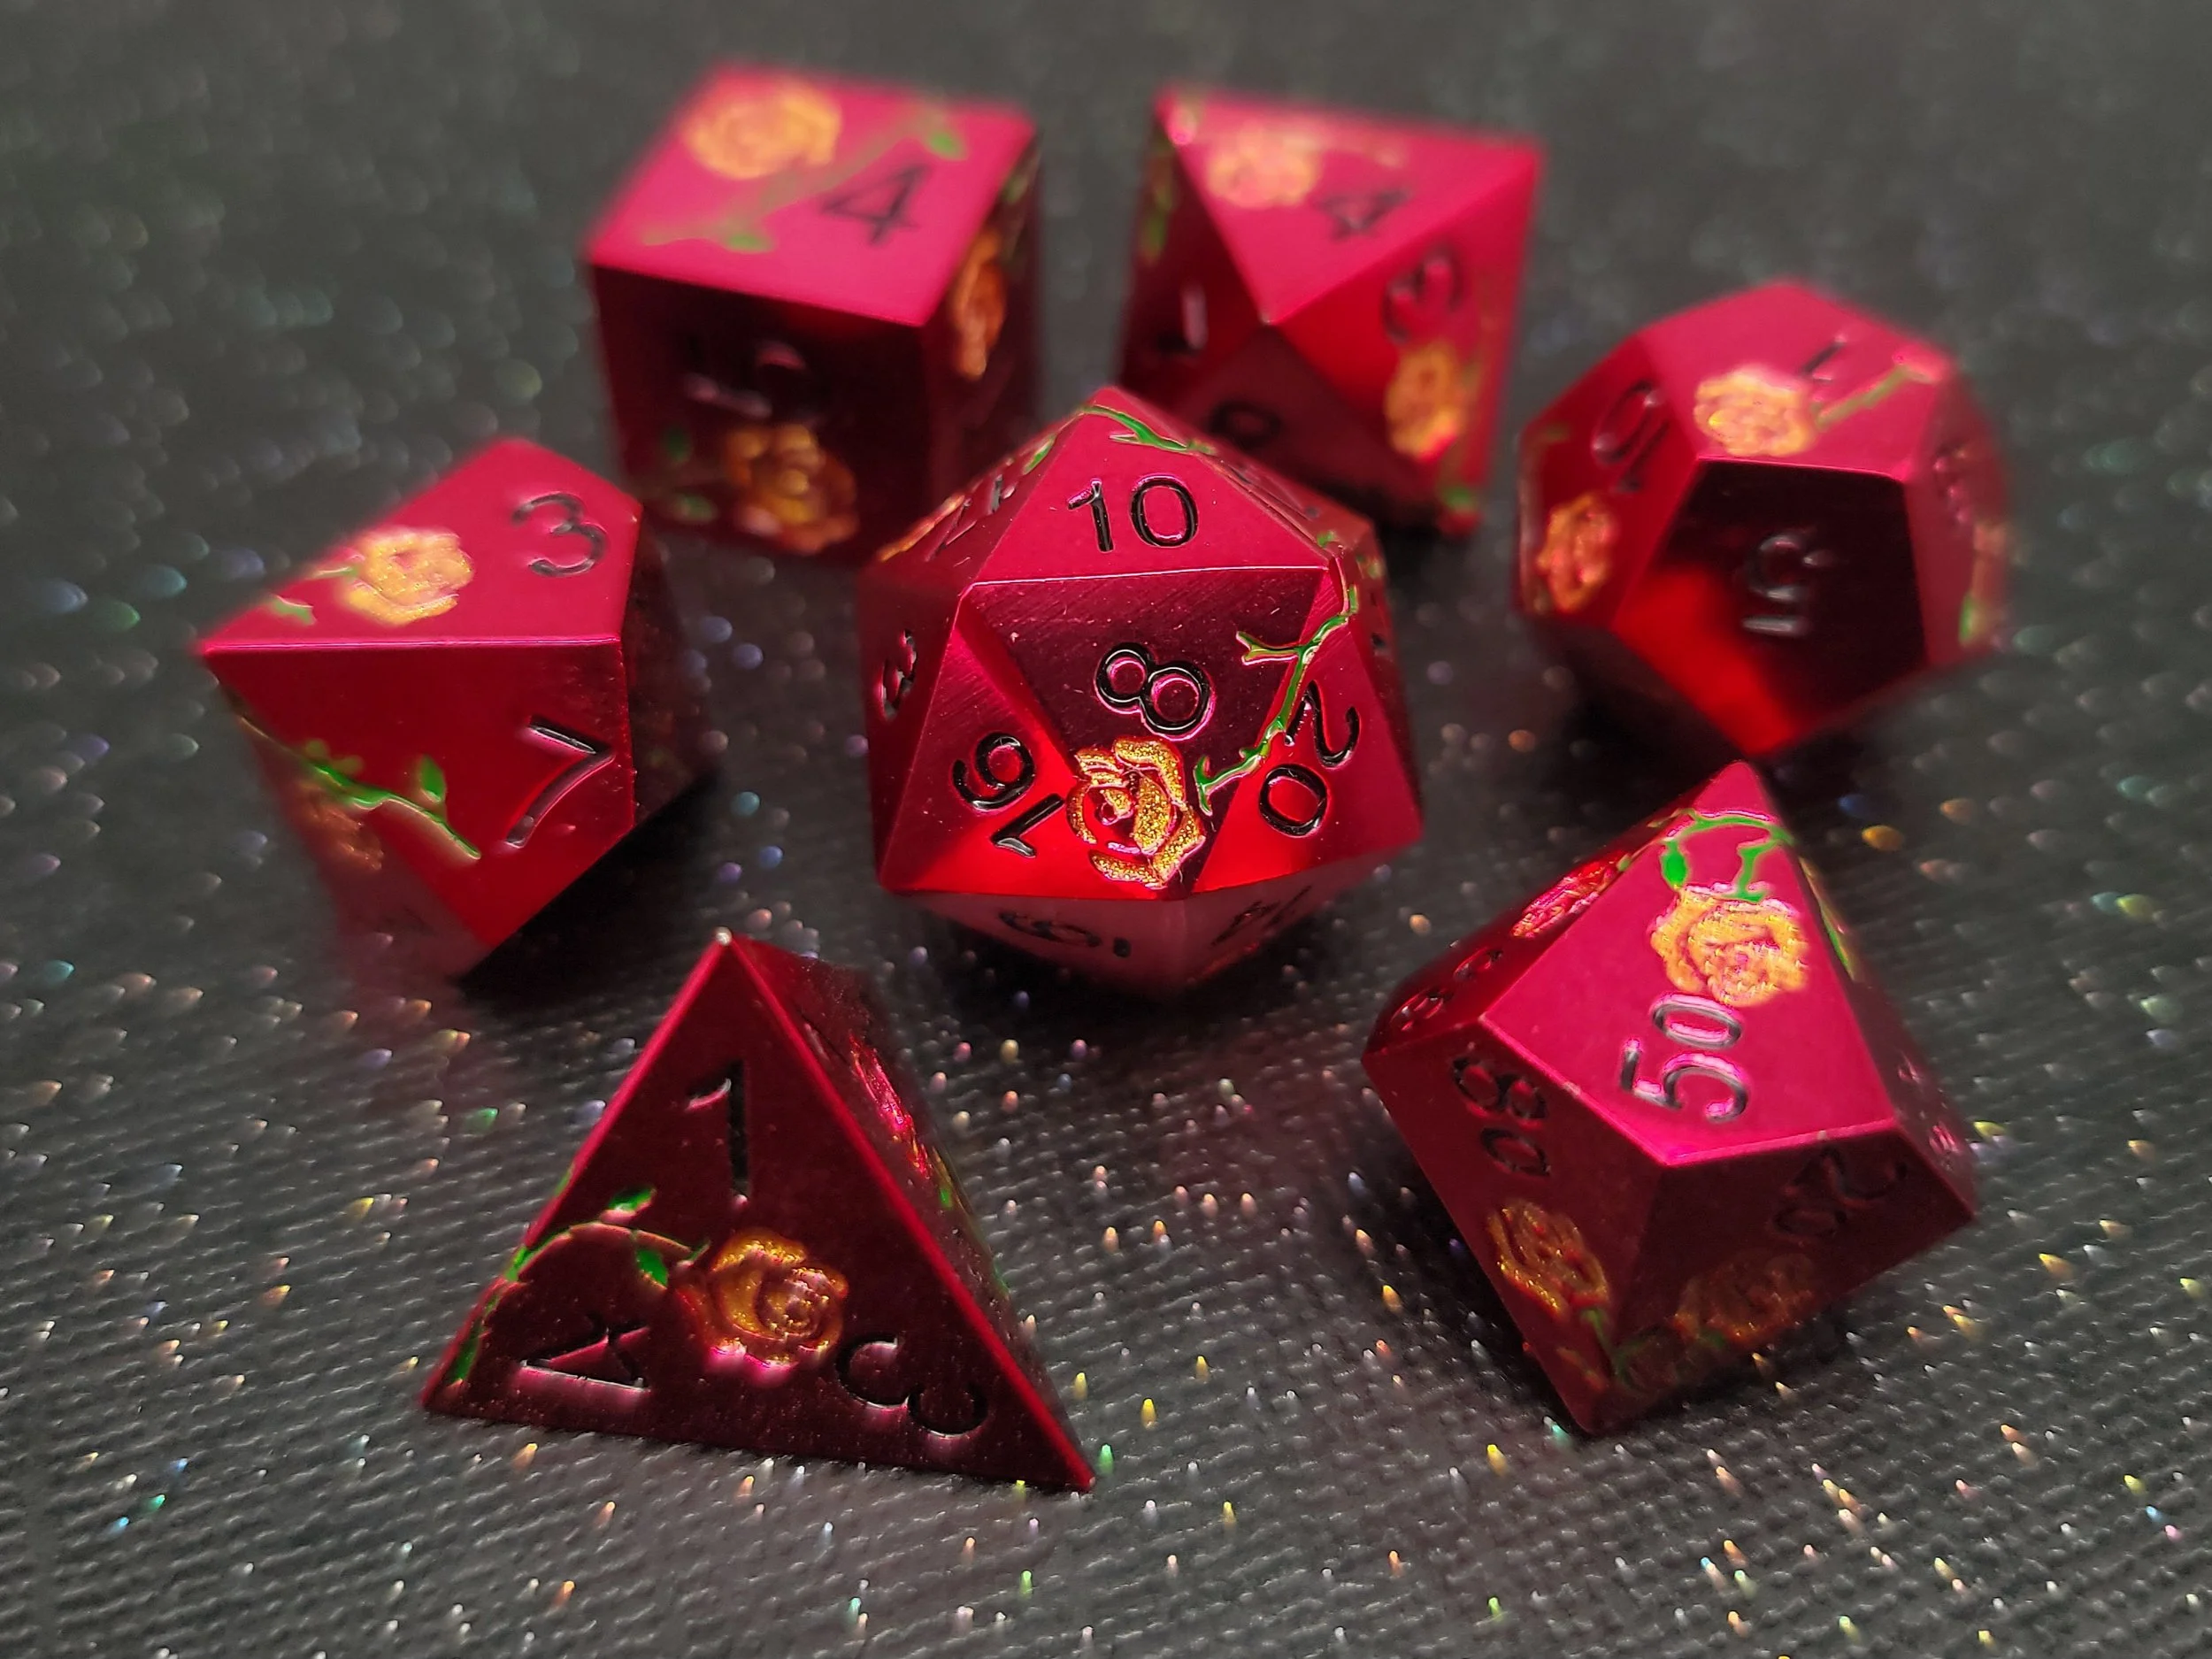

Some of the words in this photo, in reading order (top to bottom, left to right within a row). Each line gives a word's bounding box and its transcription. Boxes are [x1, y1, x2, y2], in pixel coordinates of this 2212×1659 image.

[819, 161, 933, 246] 4
[511, 490, 608, 577] 3
[1066, 472, 1200, 553] 10
[1094, 641, 1216, 740] 8
[504, 718, 616, 849] 7
[950, 731, 1065, 858] 16
[1258, 680, 1363, 838] 20
[1620, 993, 1750, 1123] 50
[685, 1059, 751, 1205] 1
[1450, 1056, 1550, 1177] 80
[520, 1310, 653, 1392] 4
[835, 1332, 989, 1436] 3
